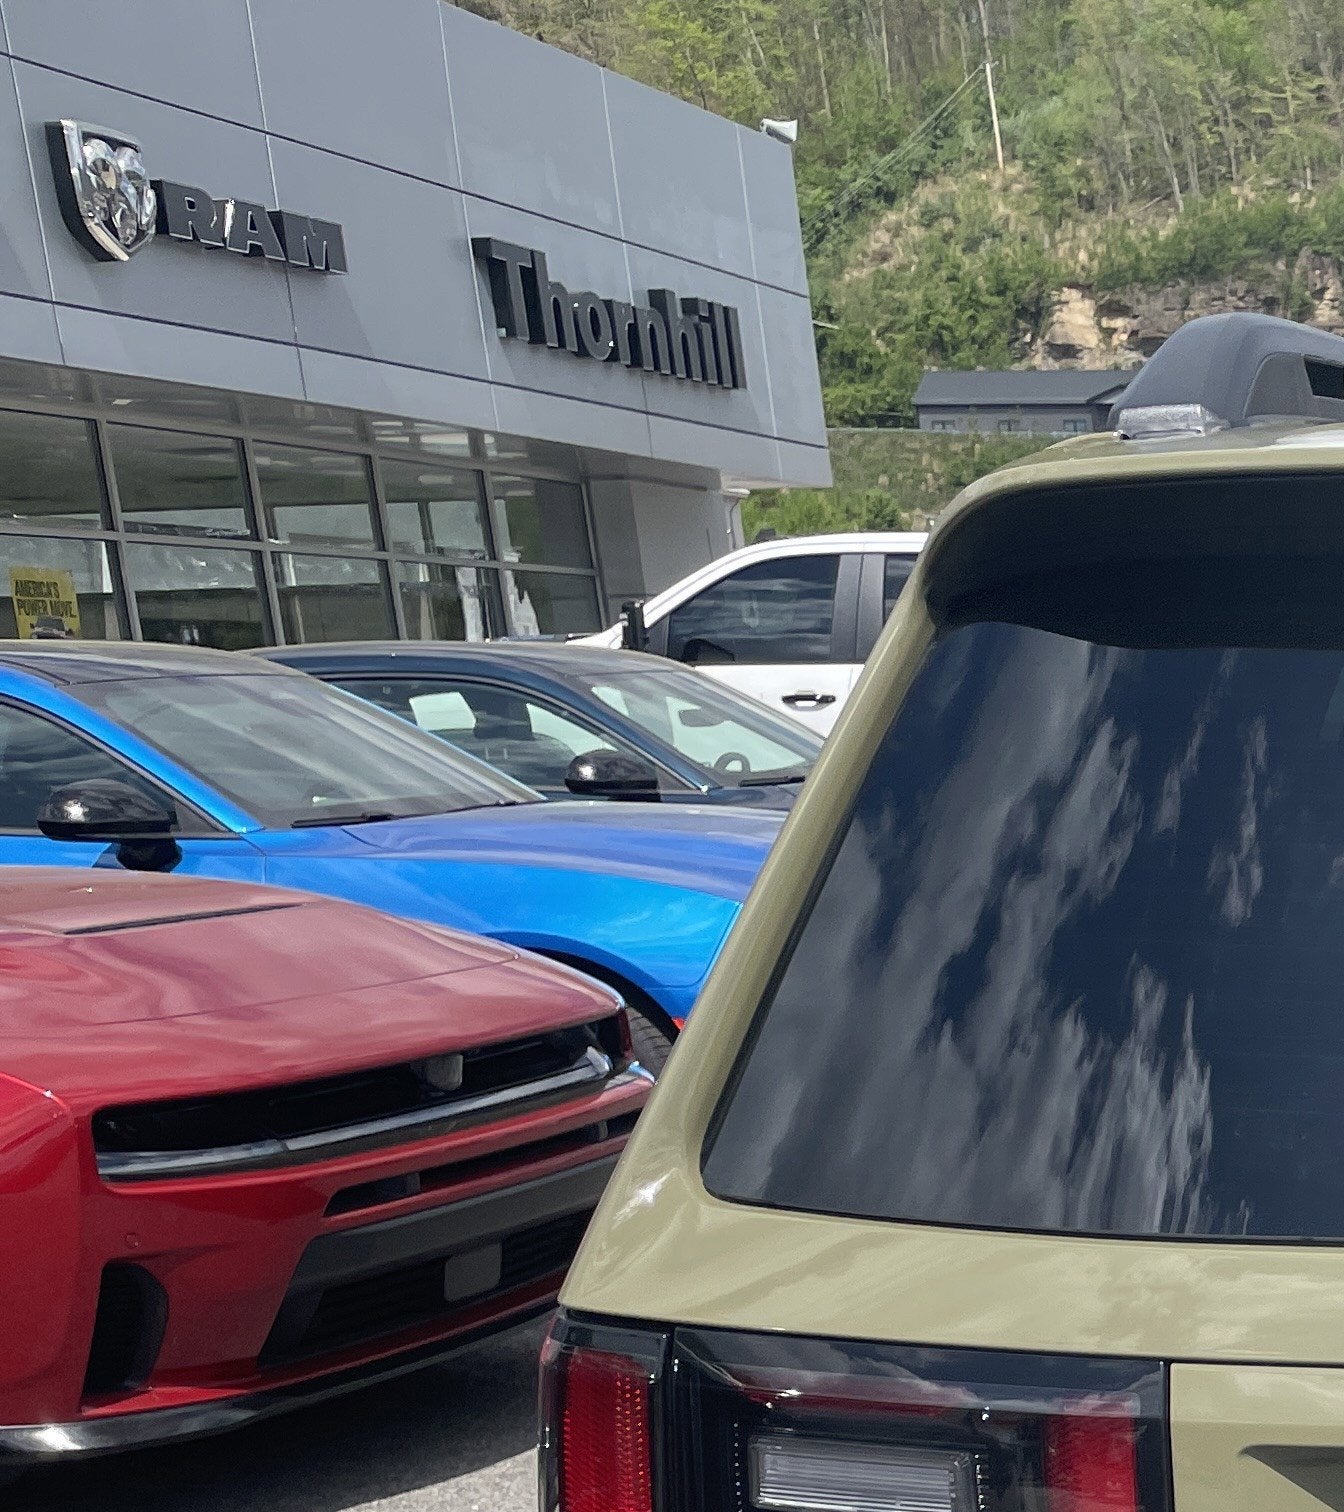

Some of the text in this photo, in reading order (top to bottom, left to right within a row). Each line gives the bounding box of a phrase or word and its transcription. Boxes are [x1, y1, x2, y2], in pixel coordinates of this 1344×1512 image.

[152, 178, 349, 275] RAM
[470, 236, 748, 390] Thornhill
[17, 598, 49, 617] POWER
